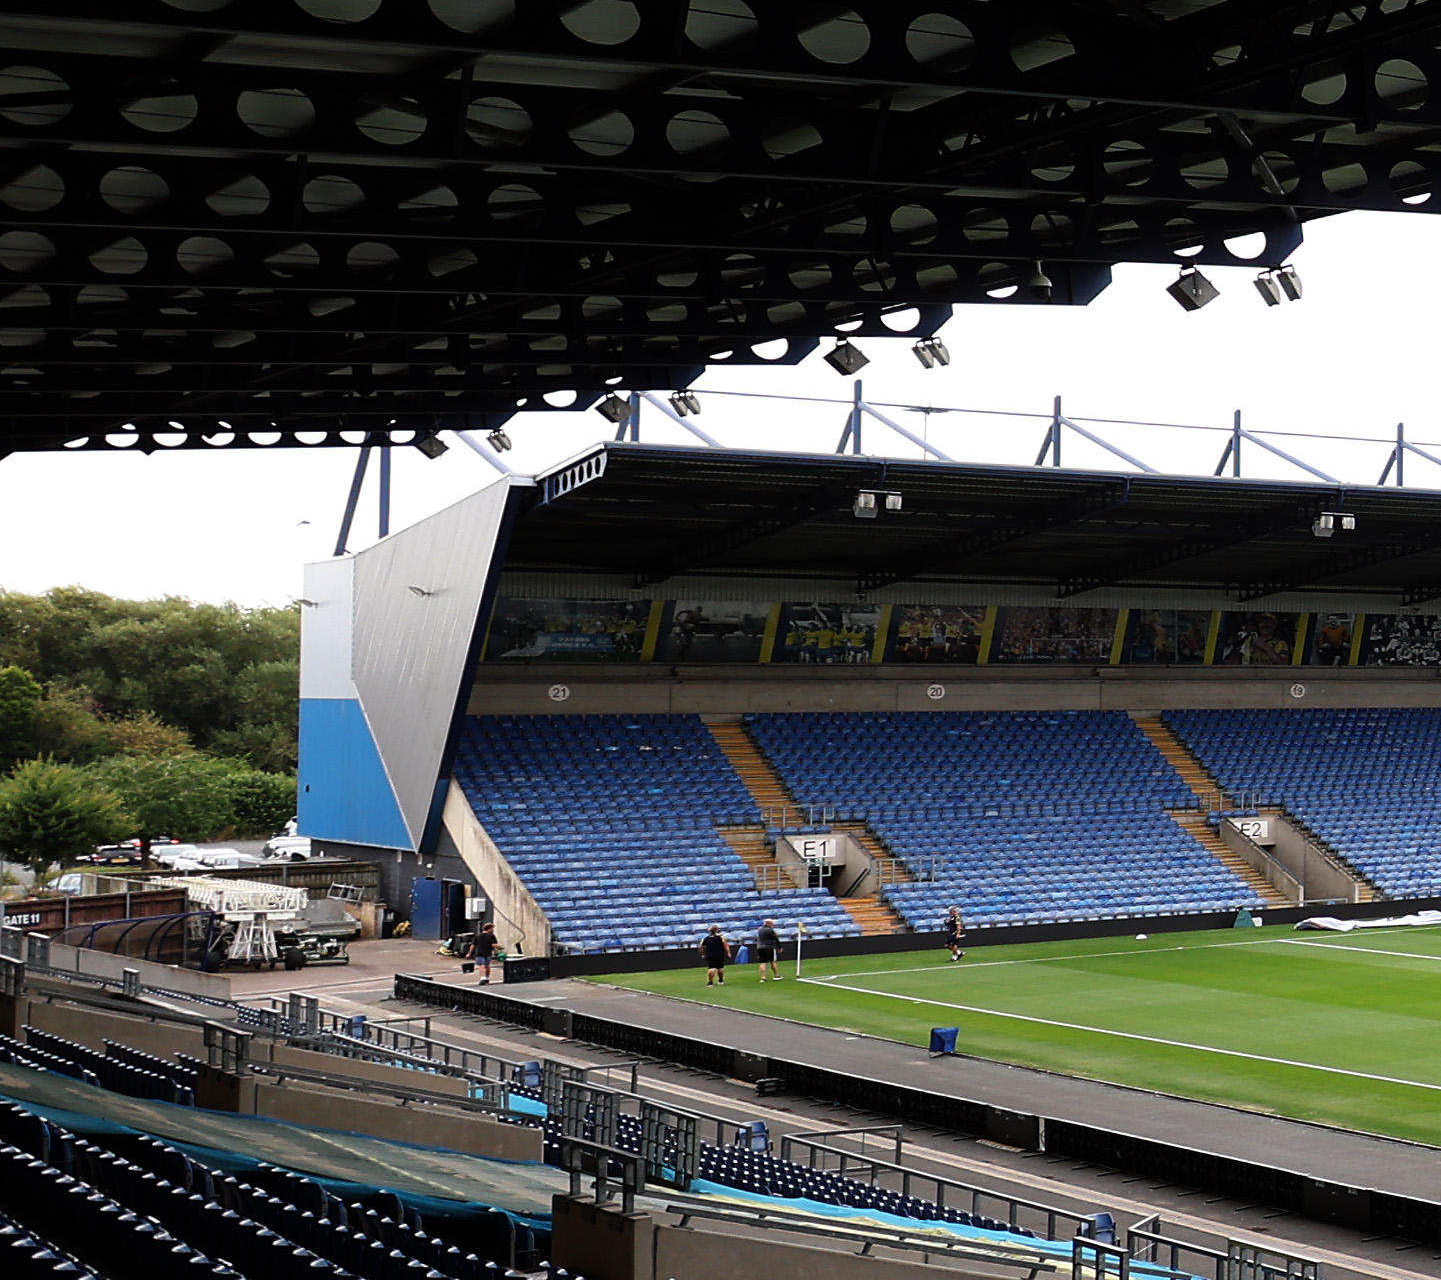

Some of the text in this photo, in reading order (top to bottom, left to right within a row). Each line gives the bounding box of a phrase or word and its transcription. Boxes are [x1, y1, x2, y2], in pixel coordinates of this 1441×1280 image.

[552, 688, 567, 699] 21
[930, 687, 941, 697] 20
[1293, 685, 1303, 695] 19
[1241, 822, 1261, 838] E2
[803, 840, 828, 857] E1
[3, 912, 41, 926] GATE 11
